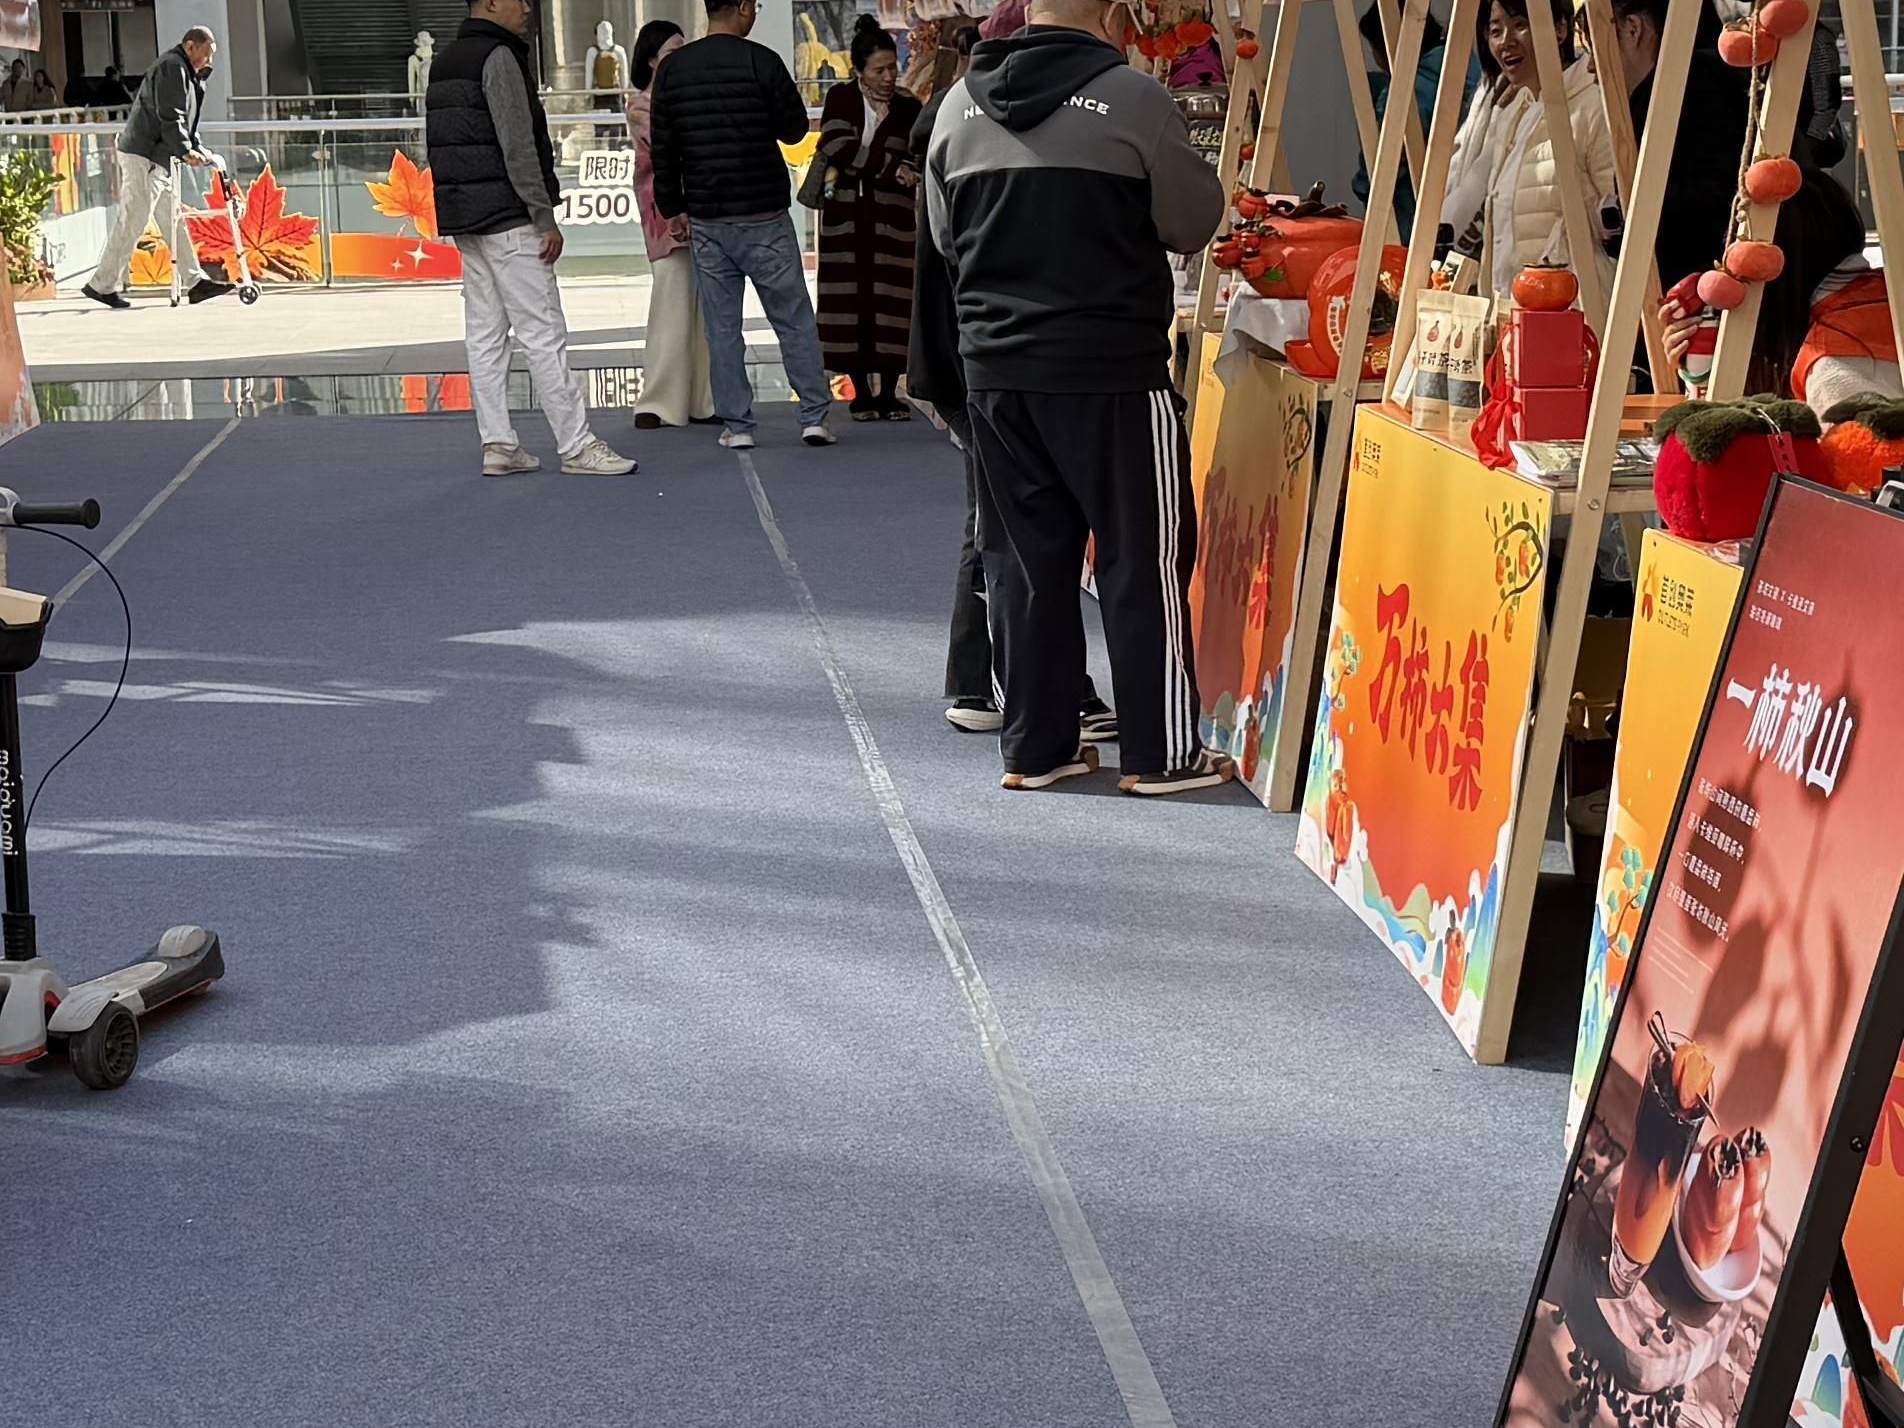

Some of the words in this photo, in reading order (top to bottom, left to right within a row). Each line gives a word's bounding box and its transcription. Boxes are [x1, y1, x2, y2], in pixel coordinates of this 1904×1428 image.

[562, 193, 631, 219] 1500
[584, 156, 631, 181] 限时
[1367, 584, 1490, 811] 万柿大集
[1726, 663, 1854, 798] 一柿秋山
